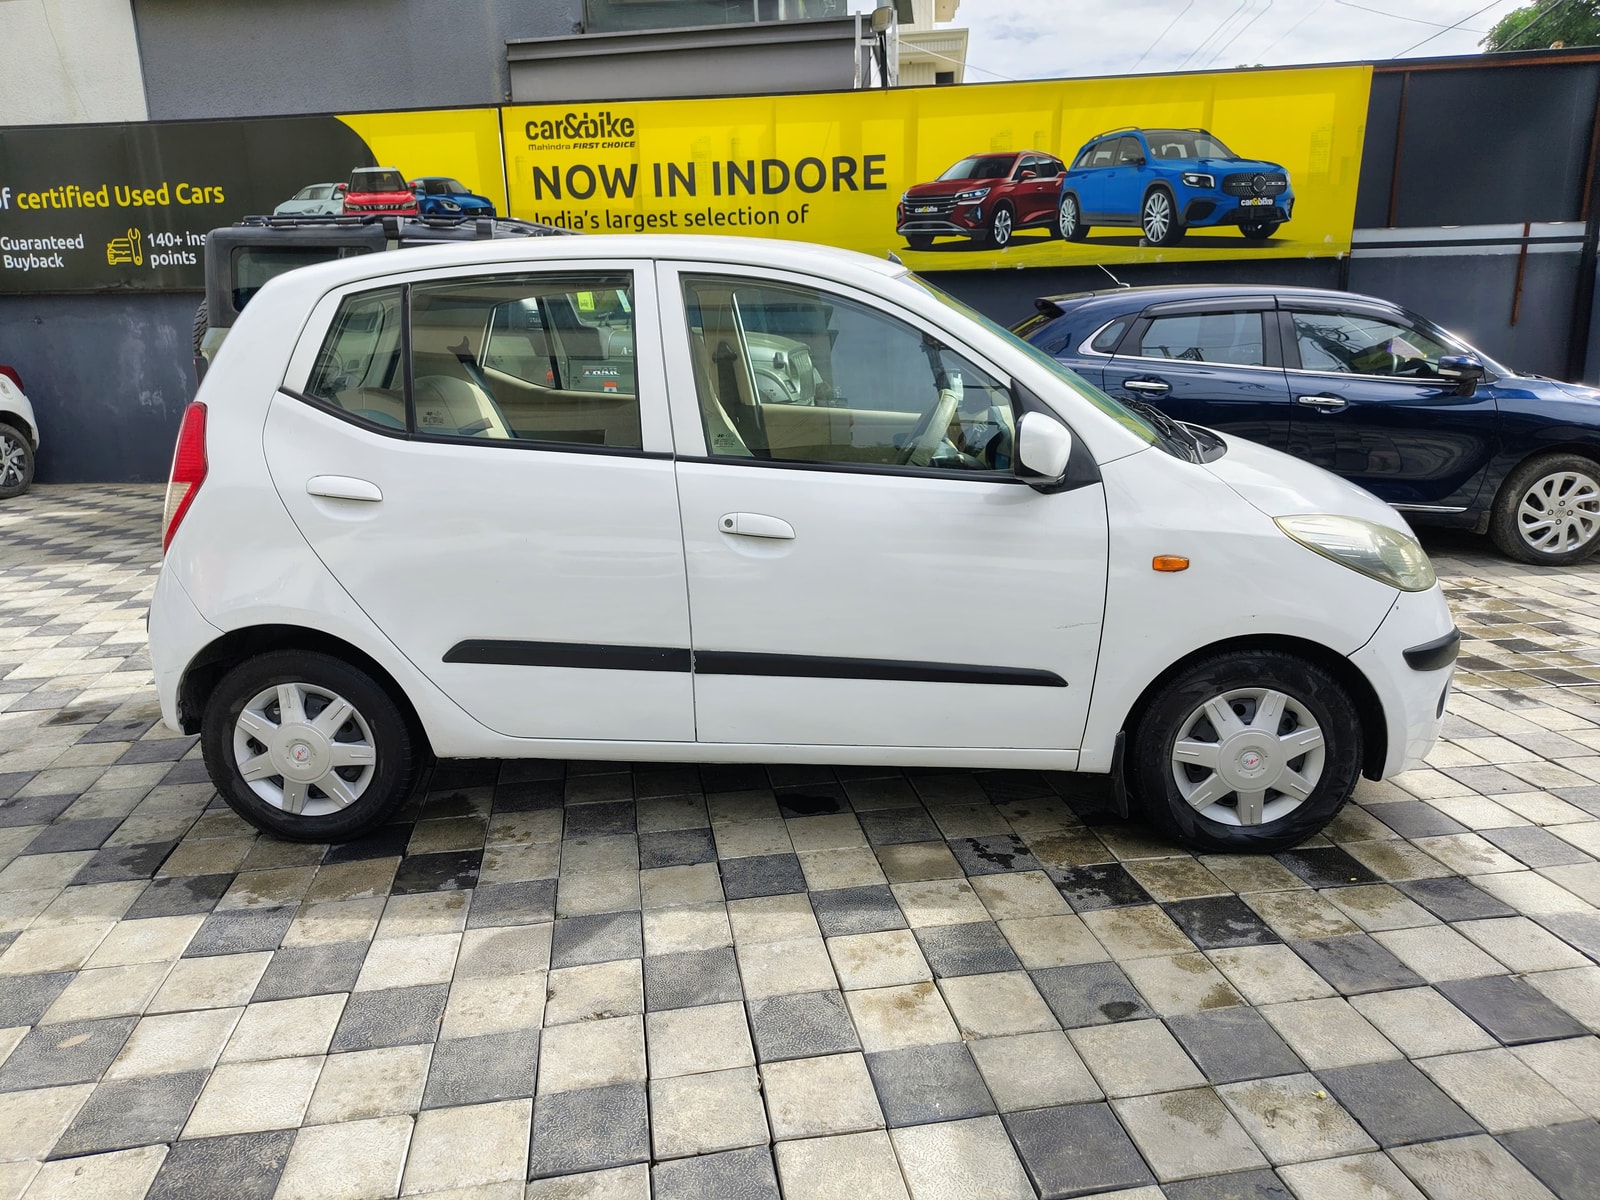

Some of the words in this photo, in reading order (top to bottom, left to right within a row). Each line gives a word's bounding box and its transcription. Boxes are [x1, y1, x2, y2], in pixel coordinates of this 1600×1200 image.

[525, 111, 635, 141] car&bike
[528, 143, 571, 151] Mahindra
[572, 142, 600, 150] FIRST
[601, 141, 636, 149] CHOICE
[532, 163, 638, 200] NOW
[654, 161, 697, 197] IN
[712, 154, 888, 196] INDORE
[16, 184, 109, 210] certified
[114, 181, 170, 207] Used
[175, 183, 225, 205] Cars
[605, 208, 678, 232] largest
[684, 205, 780, 227] selection
[786, 203, 810, 224] of
[0, 234, 84, 251] Guaranteed
[147, 232, 183, 248] 140+
[3, 253, 64, 272] Buyback
[150, 250, 197, 269] points
